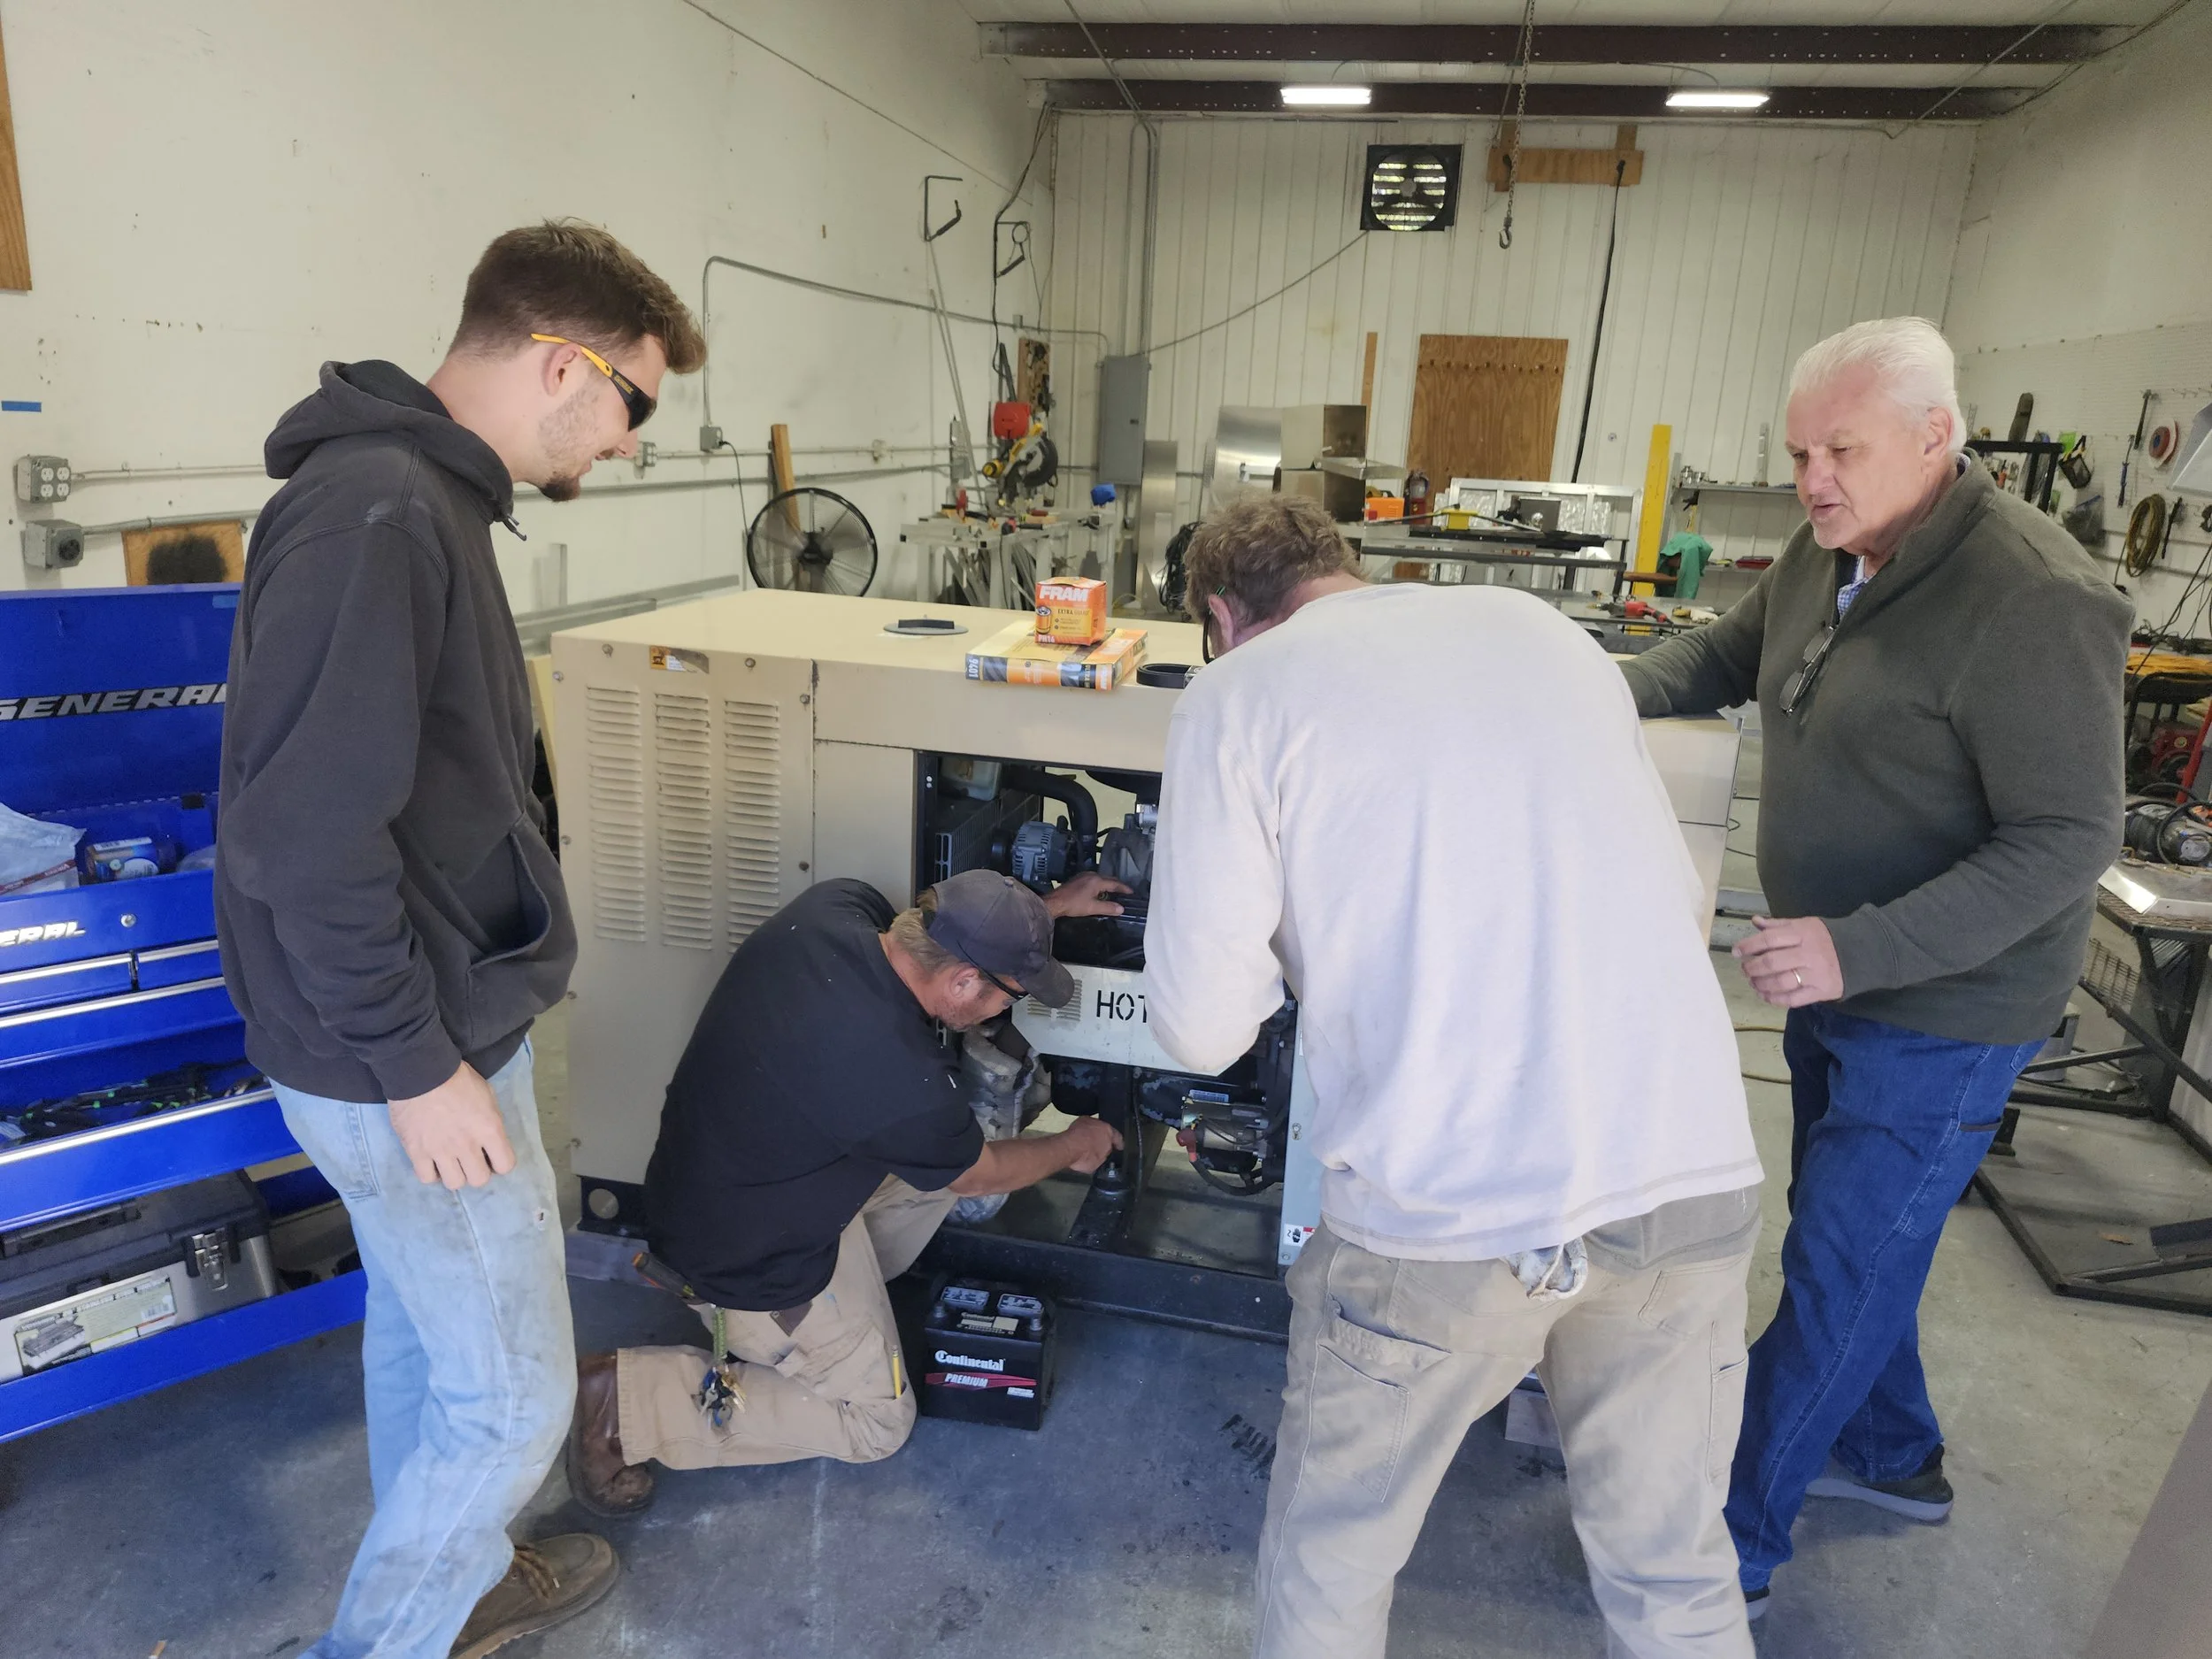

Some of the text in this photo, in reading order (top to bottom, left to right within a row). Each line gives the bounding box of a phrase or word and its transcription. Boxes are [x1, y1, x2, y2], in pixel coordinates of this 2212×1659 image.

[1039, 585, 1090, 602] FRAM
[1096, 990, 1148, 1024] HOT
[934, 1350, 1004, 1371] Continental
[945, 1372, 988, 1387] PREMIUM
